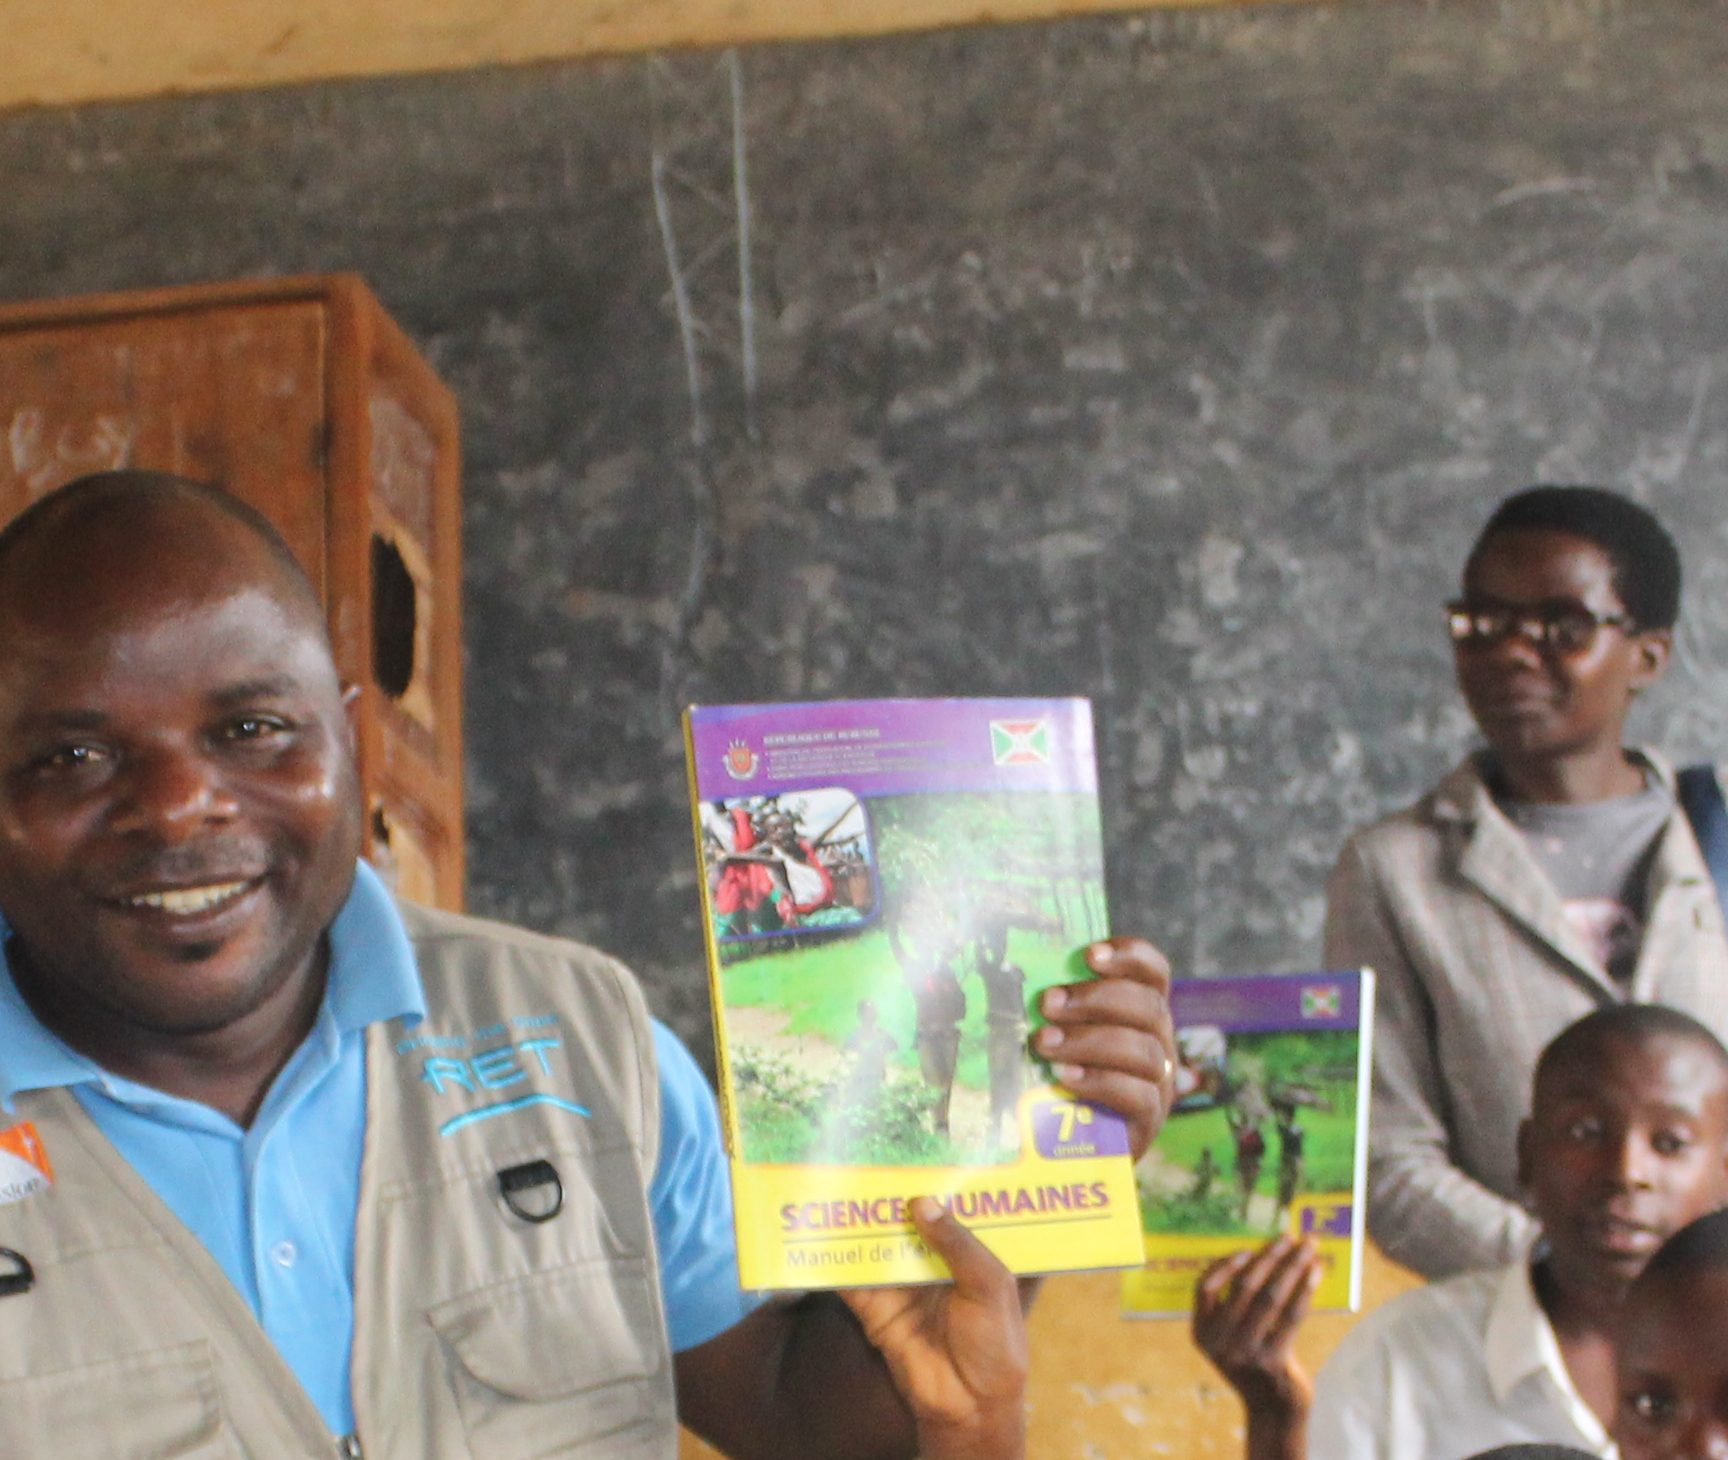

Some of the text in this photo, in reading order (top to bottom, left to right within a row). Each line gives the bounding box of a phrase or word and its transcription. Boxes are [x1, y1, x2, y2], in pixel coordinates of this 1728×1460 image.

[423, 1038, 561, 1094] RET
[780, 1182, 1110, 1232] SCIENCE UMAINES
[786, 1244, 864, 1267] Manuel
[869, 1242, 894, 1263] de
